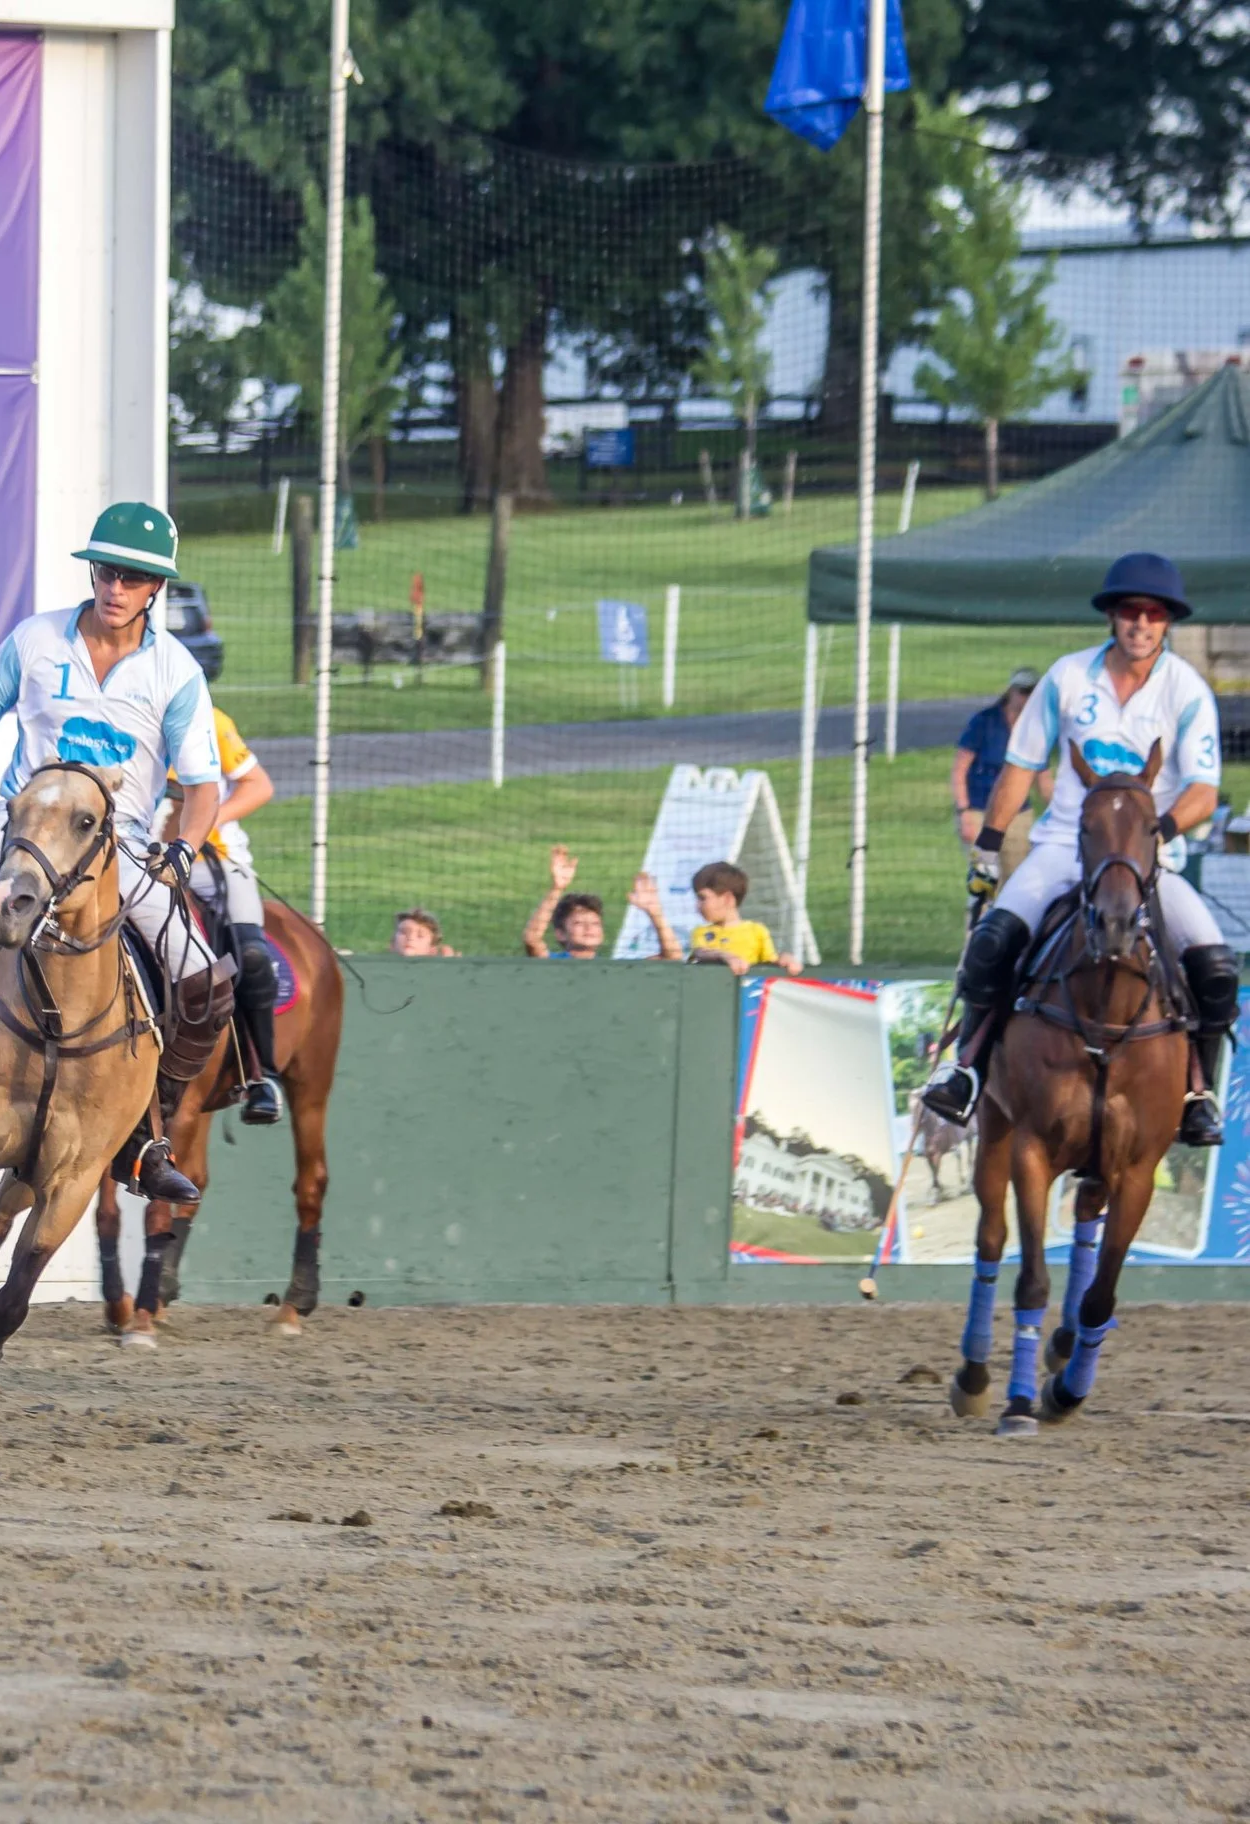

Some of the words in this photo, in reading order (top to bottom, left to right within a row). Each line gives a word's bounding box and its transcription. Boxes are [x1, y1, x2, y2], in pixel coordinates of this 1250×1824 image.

[51, 662, 75, 700] 1
[1075, 692, 1099, 725] 3
[1196, 734, 1216, 769] 3
